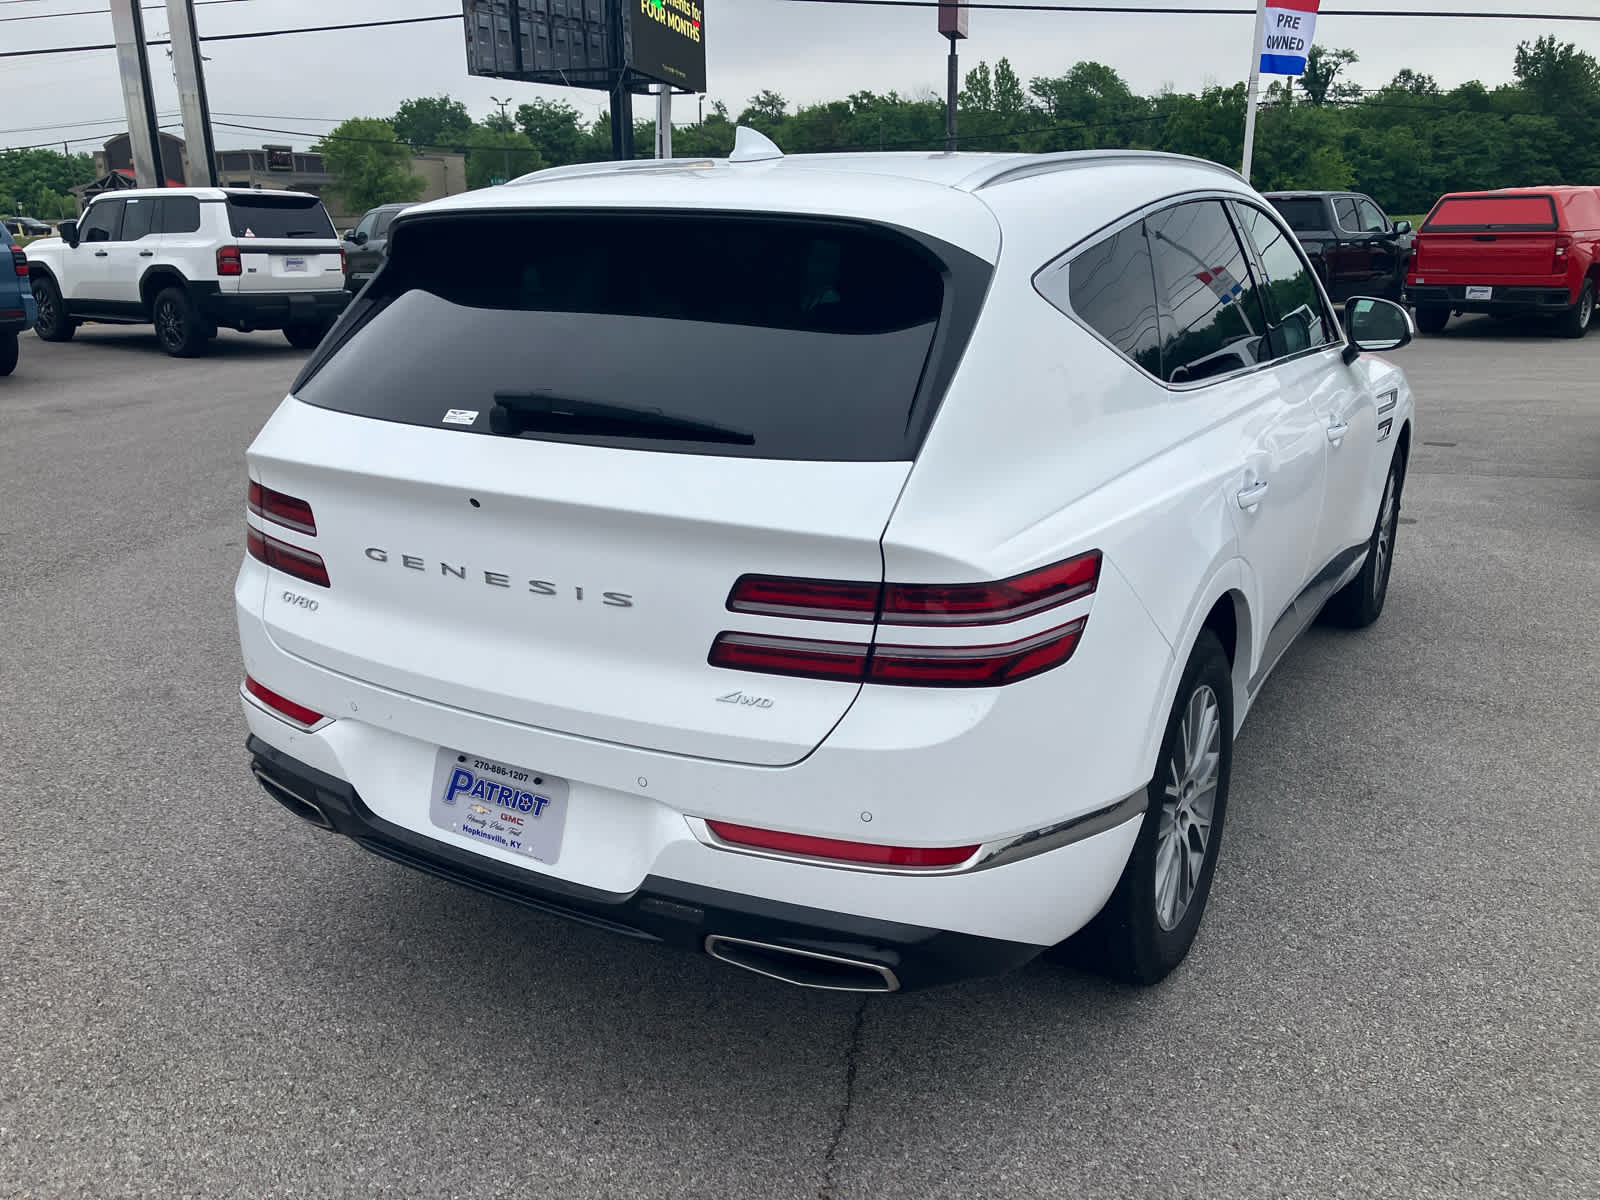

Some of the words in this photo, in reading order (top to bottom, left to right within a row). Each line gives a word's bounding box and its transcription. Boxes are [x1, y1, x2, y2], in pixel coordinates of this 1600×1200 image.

[640, 0, 666, 25] FOUR
[667, 10, 700, 43] MONTHS
[691, 2, 702, 22] for
[1277, 13, 1302, 30] PRE
[1266, 34, 1305, 51] OWNED
[364, 547, 634, 608] GENESIS
[283, 591, 319, 611] GV80
[474, 759, 529, 783] 270-886-1207
[444, 766, 550, 818] PATRIOT
[500, 812, 525, 826] GMC
[462, 824, 509, 847] Hopkinsville,
[510, 839, 522, 849] KY
